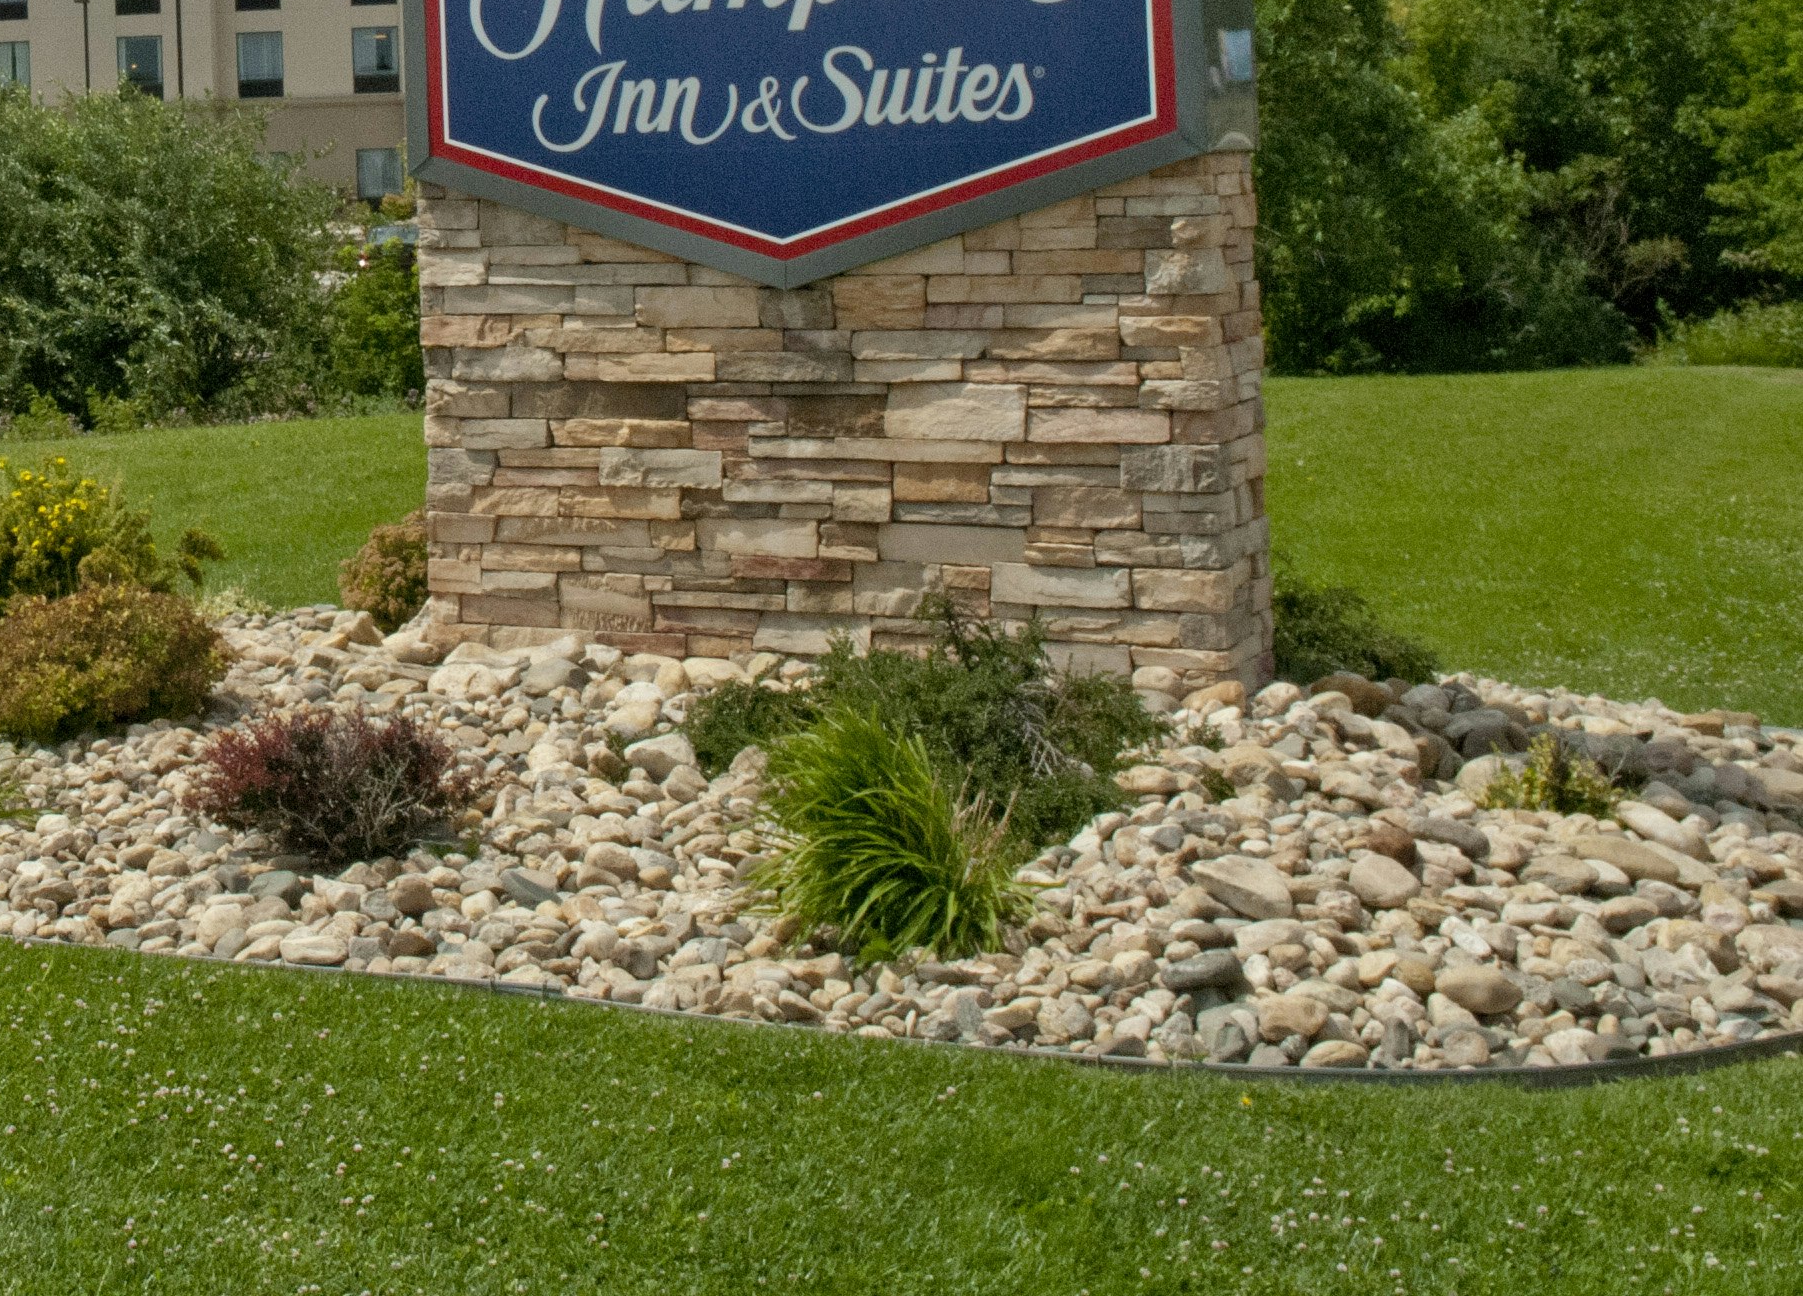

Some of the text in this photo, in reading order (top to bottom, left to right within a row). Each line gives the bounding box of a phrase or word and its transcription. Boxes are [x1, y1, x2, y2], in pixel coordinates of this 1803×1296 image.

[532, 45, 1034, 153] Inn & Suites
